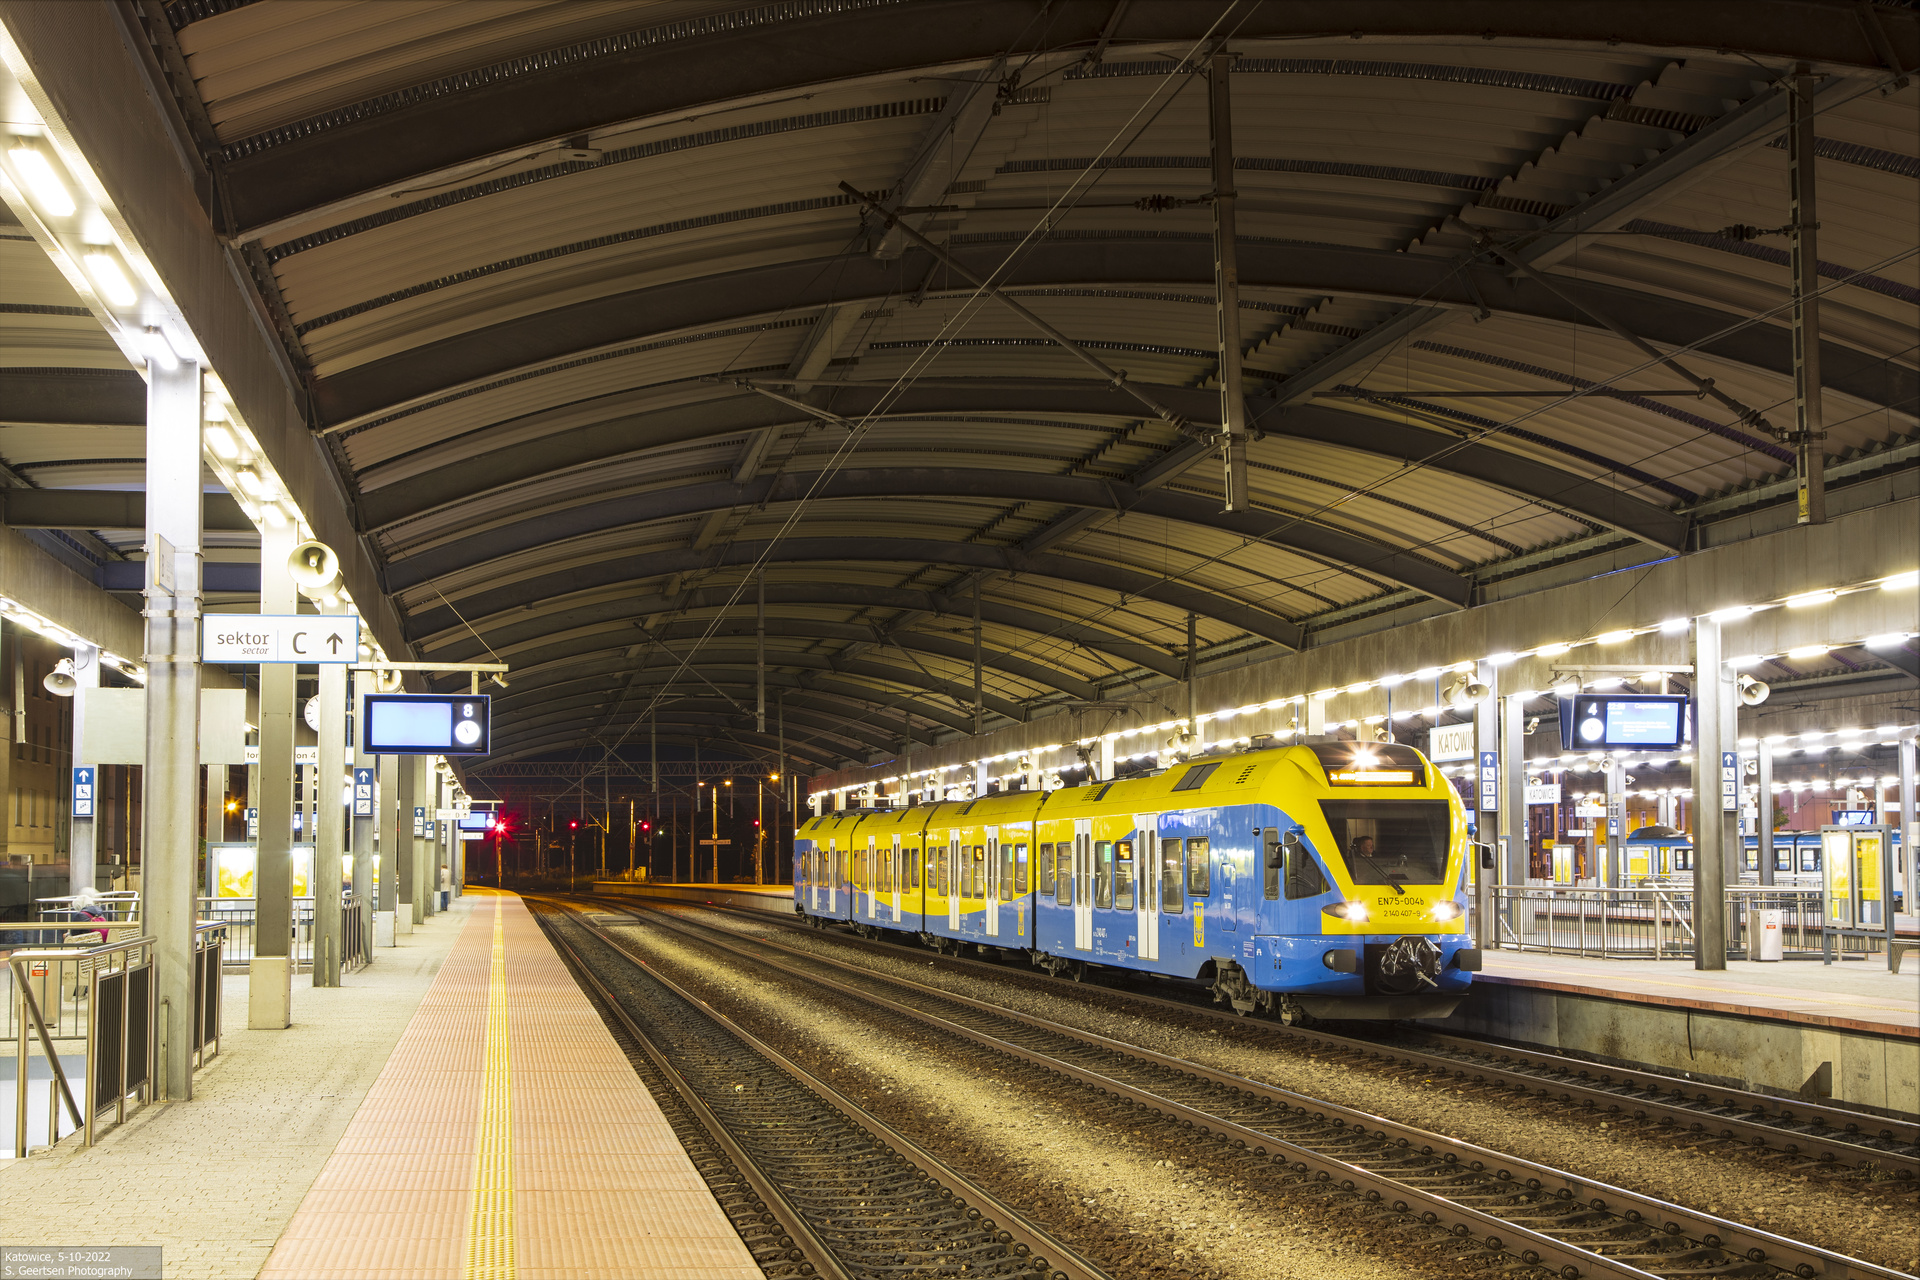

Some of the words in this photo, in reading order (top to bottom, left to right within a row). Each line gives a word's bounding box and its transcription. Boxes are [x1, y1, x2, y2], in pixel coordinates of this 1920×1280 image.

[217, 631, 270, 645] sektor
[292, 631, 307, 654] C
[241, 646, 270, 655] sector
[463, 703, 474, 718] 8
[1587, 703, 1598, 716] 4
[1529, 788, 1555, 800] KATOWICE
[1377, 897, 1425, 906] EN75-004b
